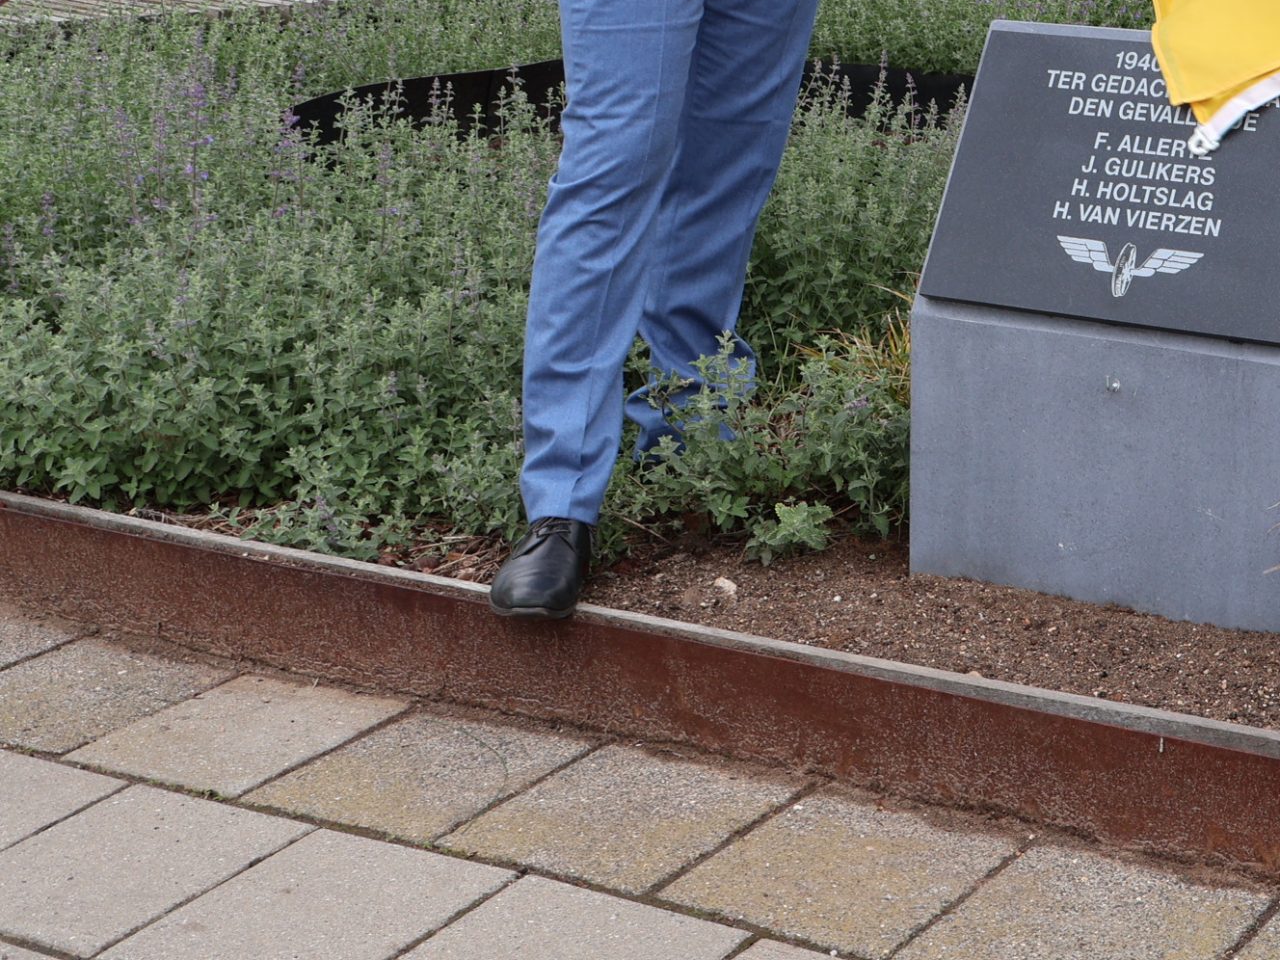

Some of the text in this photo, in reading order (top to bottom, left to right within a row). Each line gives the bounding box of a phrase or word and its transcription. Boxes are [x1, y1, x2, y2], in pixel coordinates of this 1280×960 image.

[1047, 69, 1086, 90] TER
[1091, 73, 1169, 98] GEDAC
[1068, 96, 1113, 118] DEN
[1094, 131, 1212, 160] F. ALLER
[1082, 155, 1216, 186] J. GULIKERS
[1071, 178, 1214, 211] H. HOLTSLAG
[1052, 200, 1222, 237] H. VAN VIERZEN
